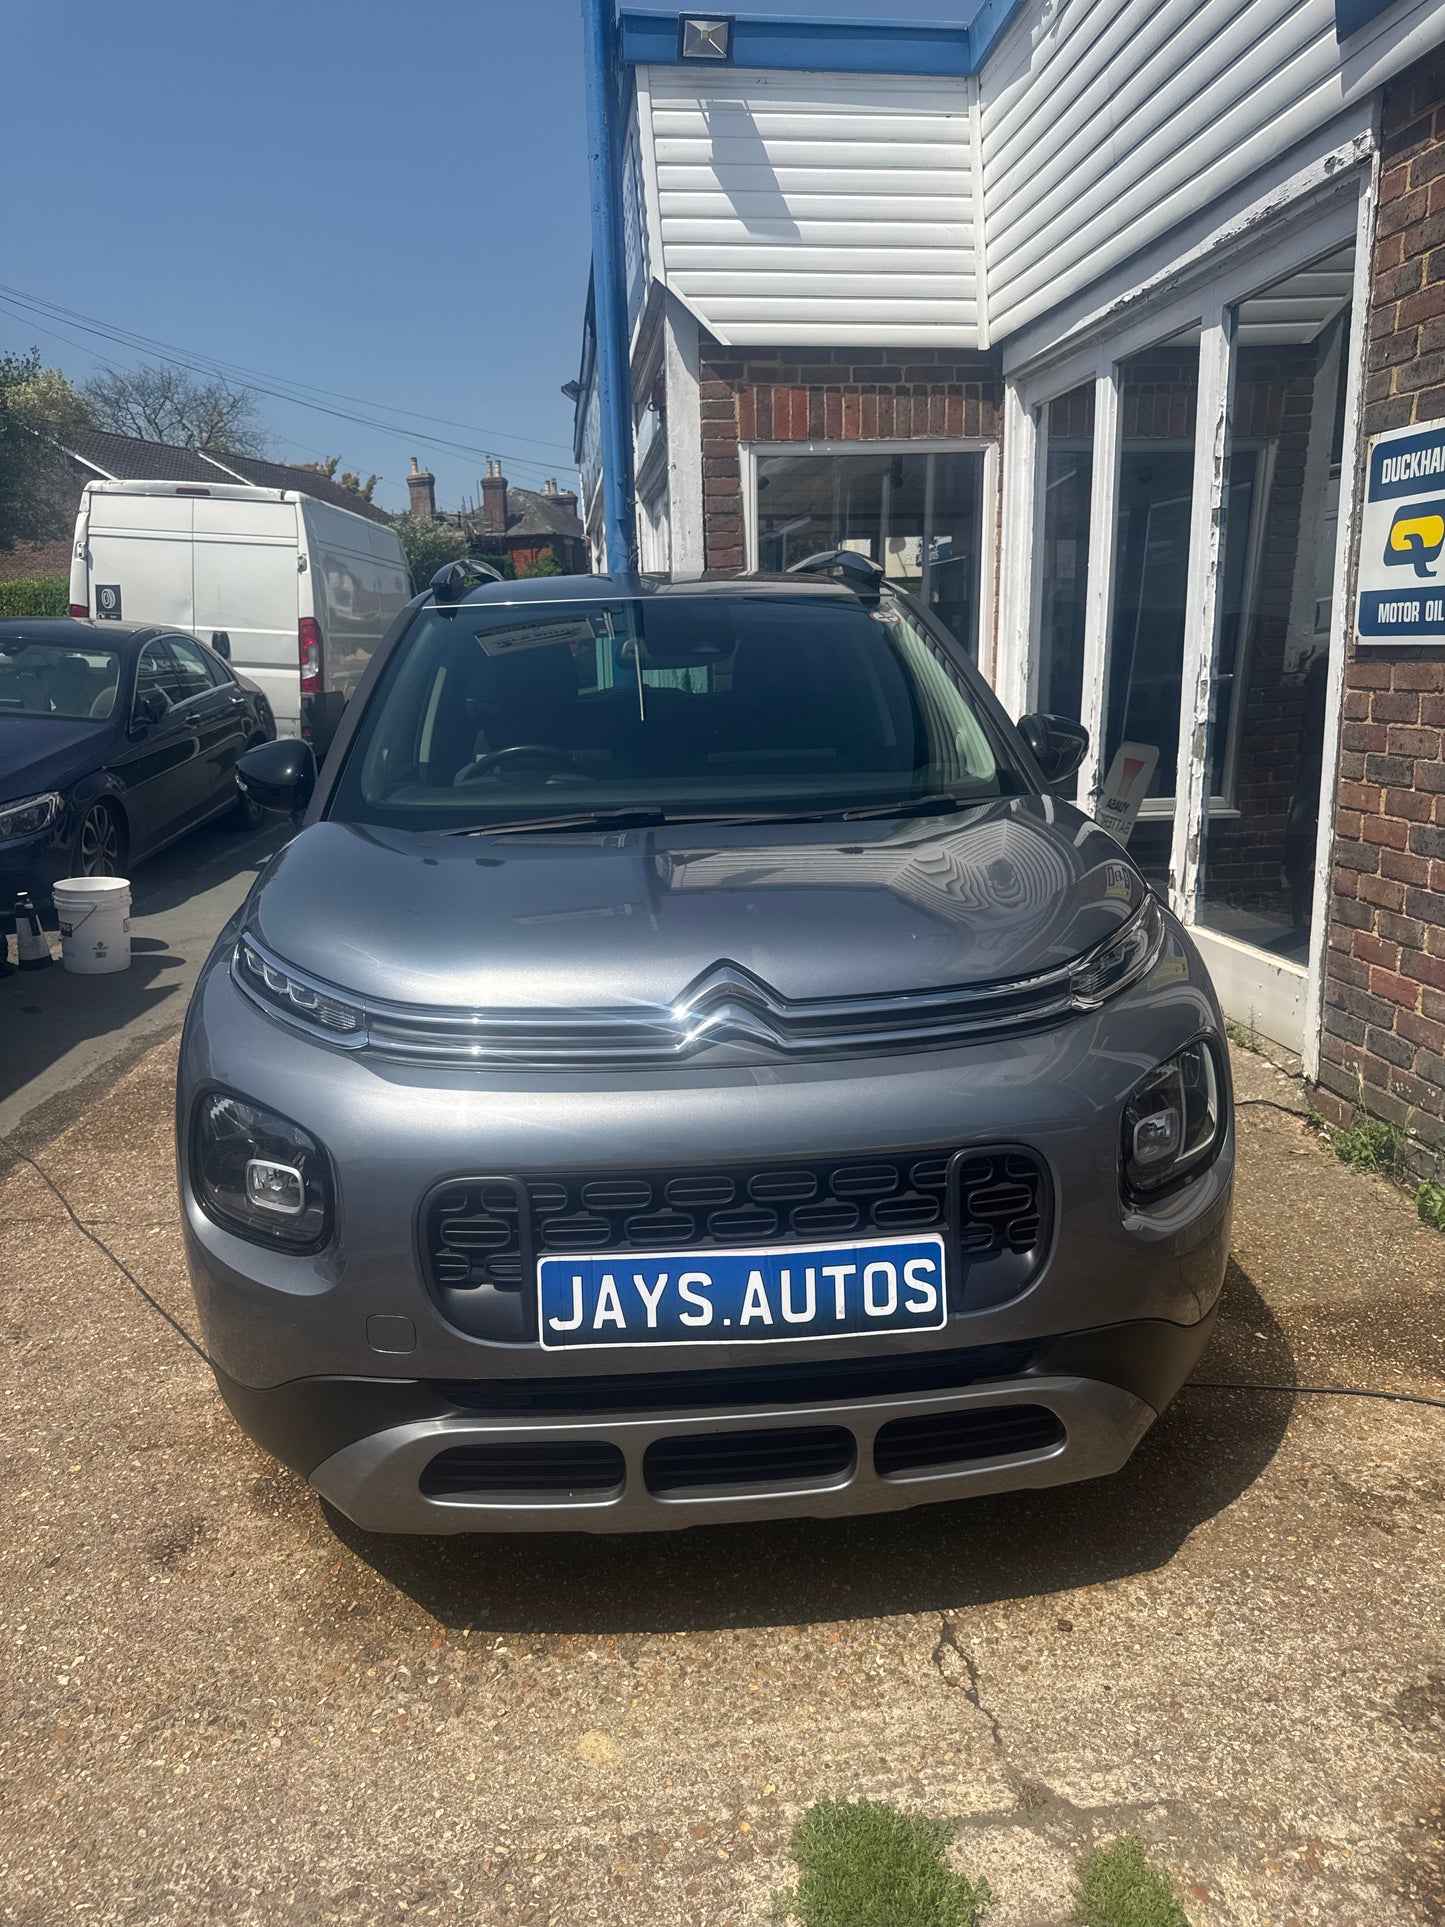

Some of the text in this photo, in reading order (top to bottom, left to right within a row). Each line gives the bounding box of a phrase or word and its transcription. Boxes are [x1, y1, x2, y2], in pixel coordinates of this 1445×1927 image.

[1378, 600, 1445, 624] MOTOR OIL
[548, 1258, 937, 1331] JAYS.AUTOS
